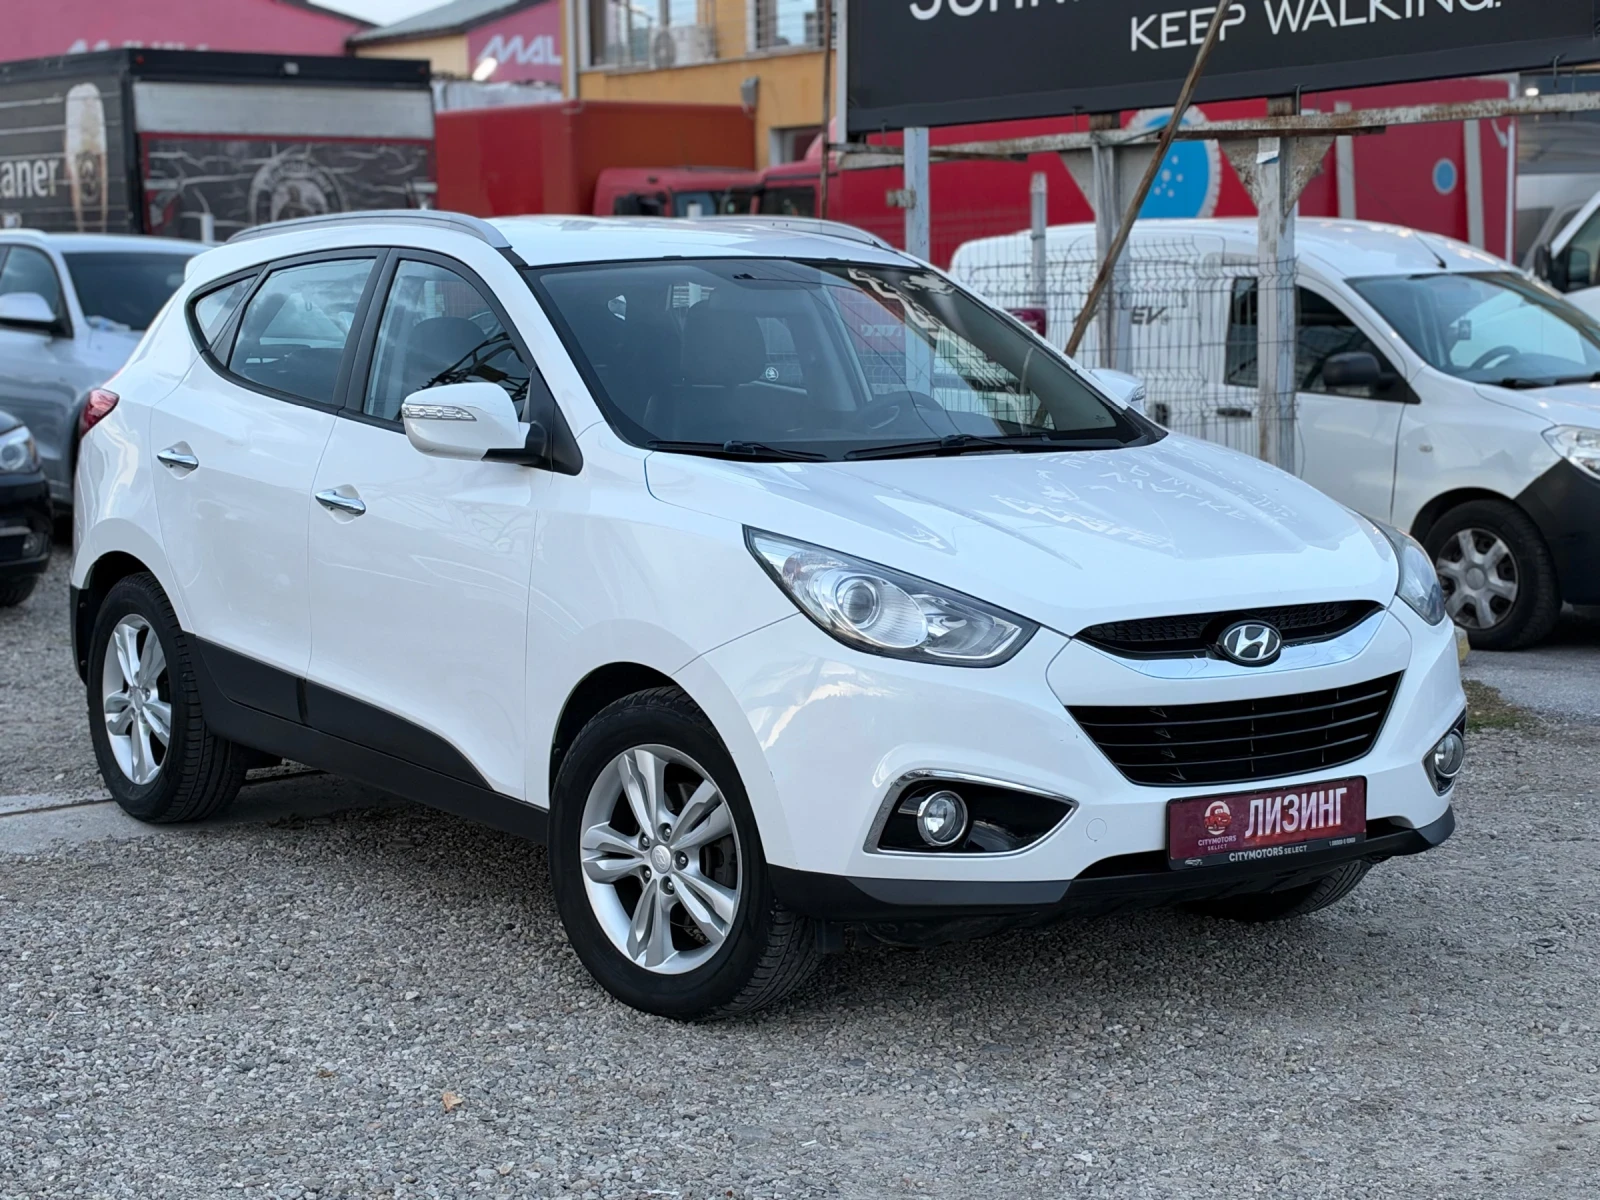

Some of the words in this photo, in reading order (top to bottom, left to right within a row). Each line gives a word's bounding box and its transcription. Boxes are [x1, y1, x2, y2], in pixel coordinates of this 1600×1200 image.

[1131, 3, 1246, 51] KEEP
[1244, 787, 1348, 839] ЛИЗИНГ
[1197, 834, 1237, 847] CITYMOTORS
[1207, 843, 1228, 851] SELECT
[1228, 846, 1283, 862] CITYMOTORS
[1283, 845, 1308, 855] SELECT
